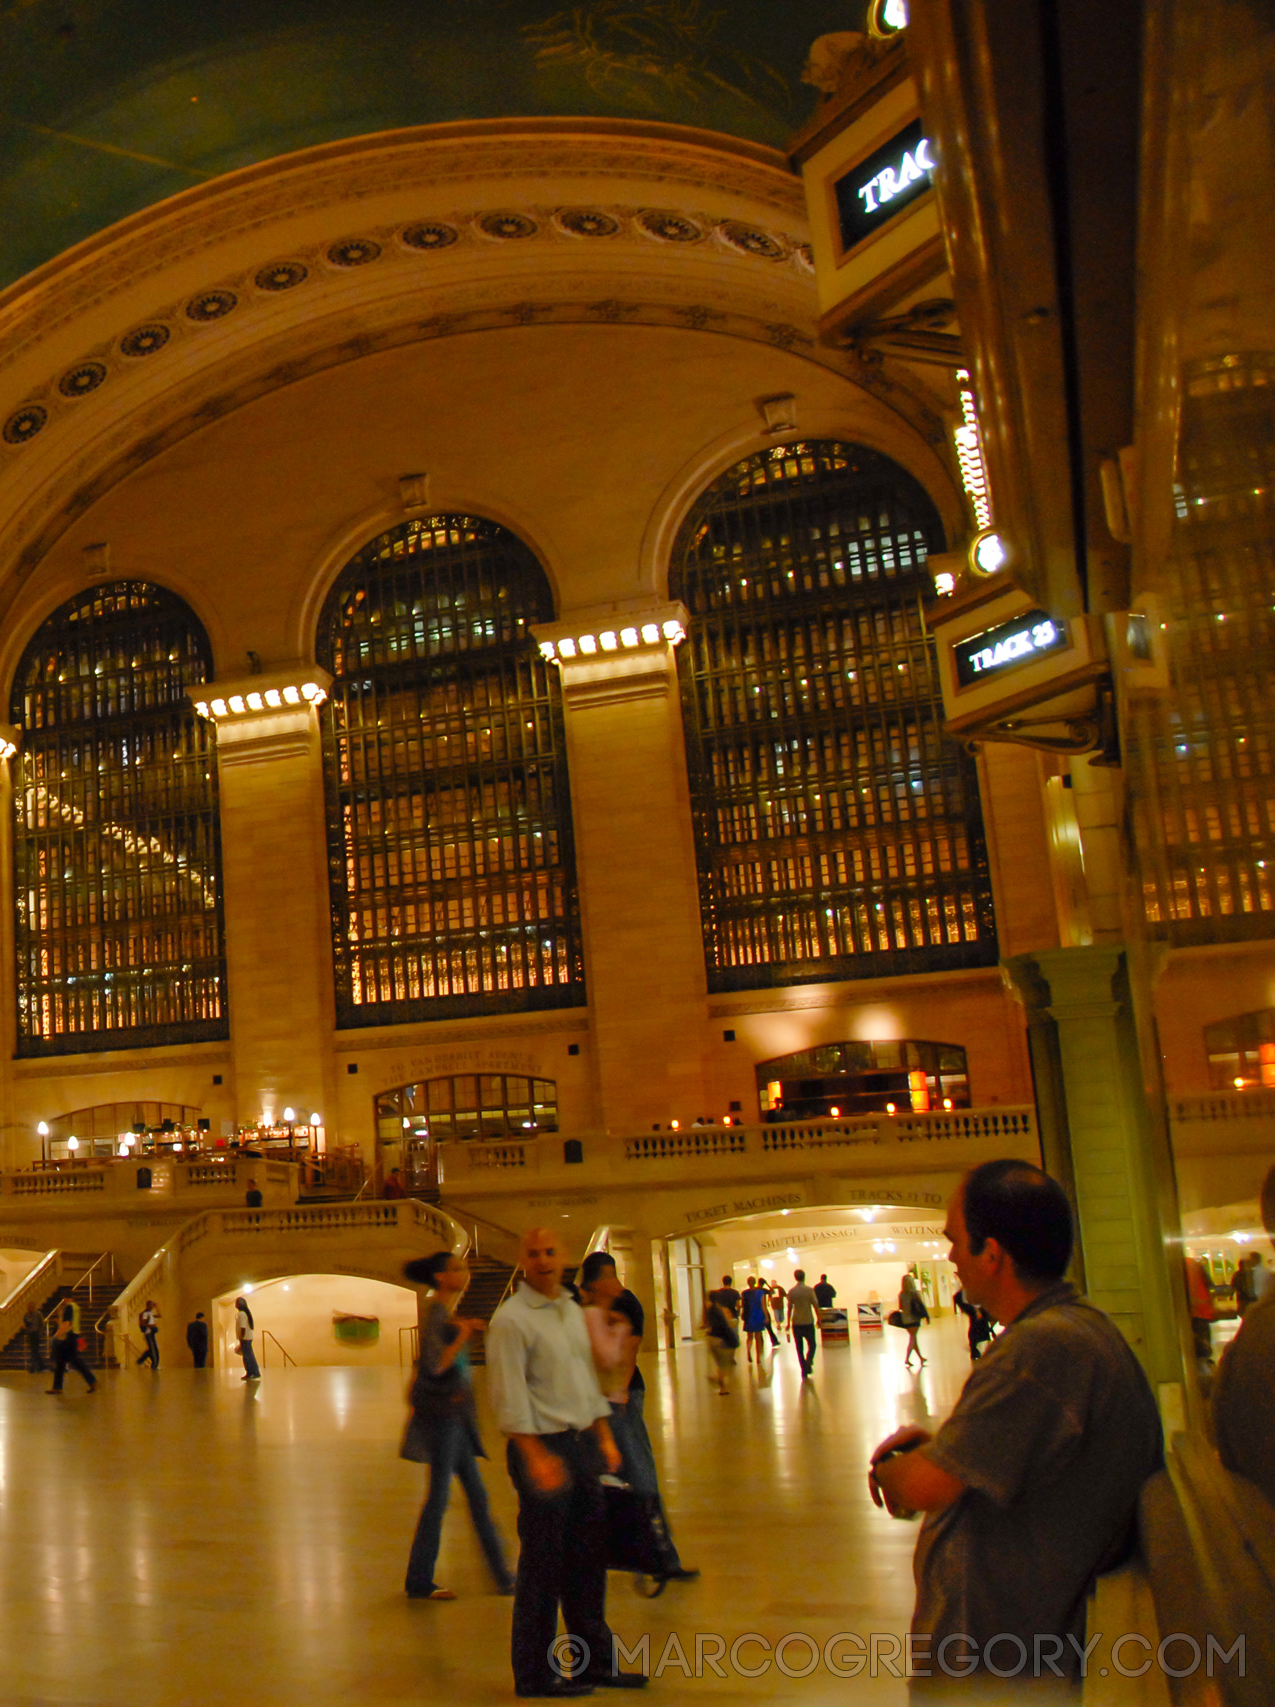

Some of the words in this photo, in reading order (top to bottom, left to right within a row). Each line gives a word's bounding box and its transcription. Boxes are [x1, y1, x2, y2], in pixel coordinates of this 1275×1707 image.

[858, 137, 937, 214] TRAC
[968, 630, 1034, 673] TRACK
[684, 1204, 727, 1223] TICKET
[733, 1193, 802, 1212] MACHINES
[849, 1189, 903, 1202] TRACKS
[924, 1193, 943, 1205] TO
[760, 1234, 808, 1250] SHUTTLE
[891, 1225, 944, 1236] WAITING
